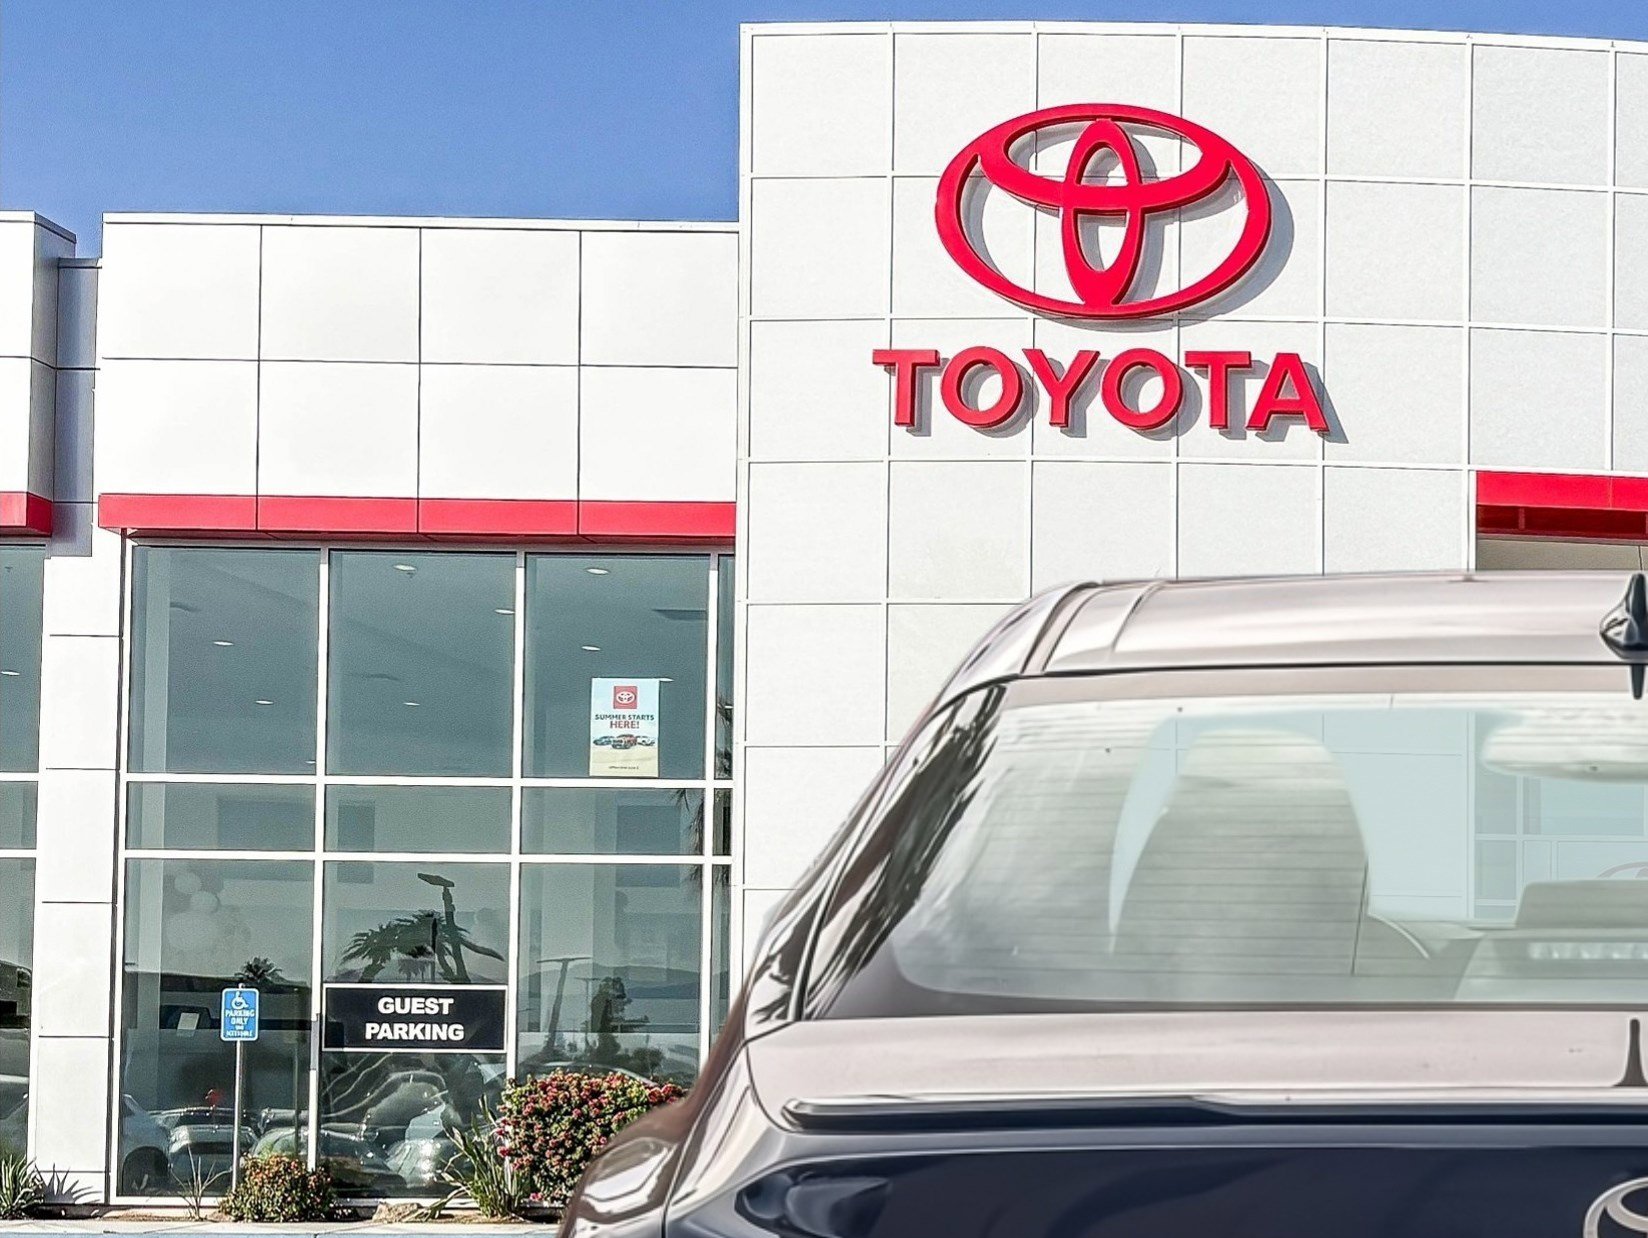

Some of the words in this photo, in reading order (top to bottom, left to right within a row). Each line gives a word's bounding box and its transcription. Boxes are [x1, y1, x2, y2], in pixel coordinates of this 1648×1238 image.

[873, 345, 1330, 433] TOYOTA
[609, 721, 640, 729] HERE!
[377, 997, 454, 1015] GUEST
[365, 1022, 464, 1041] PARKING
